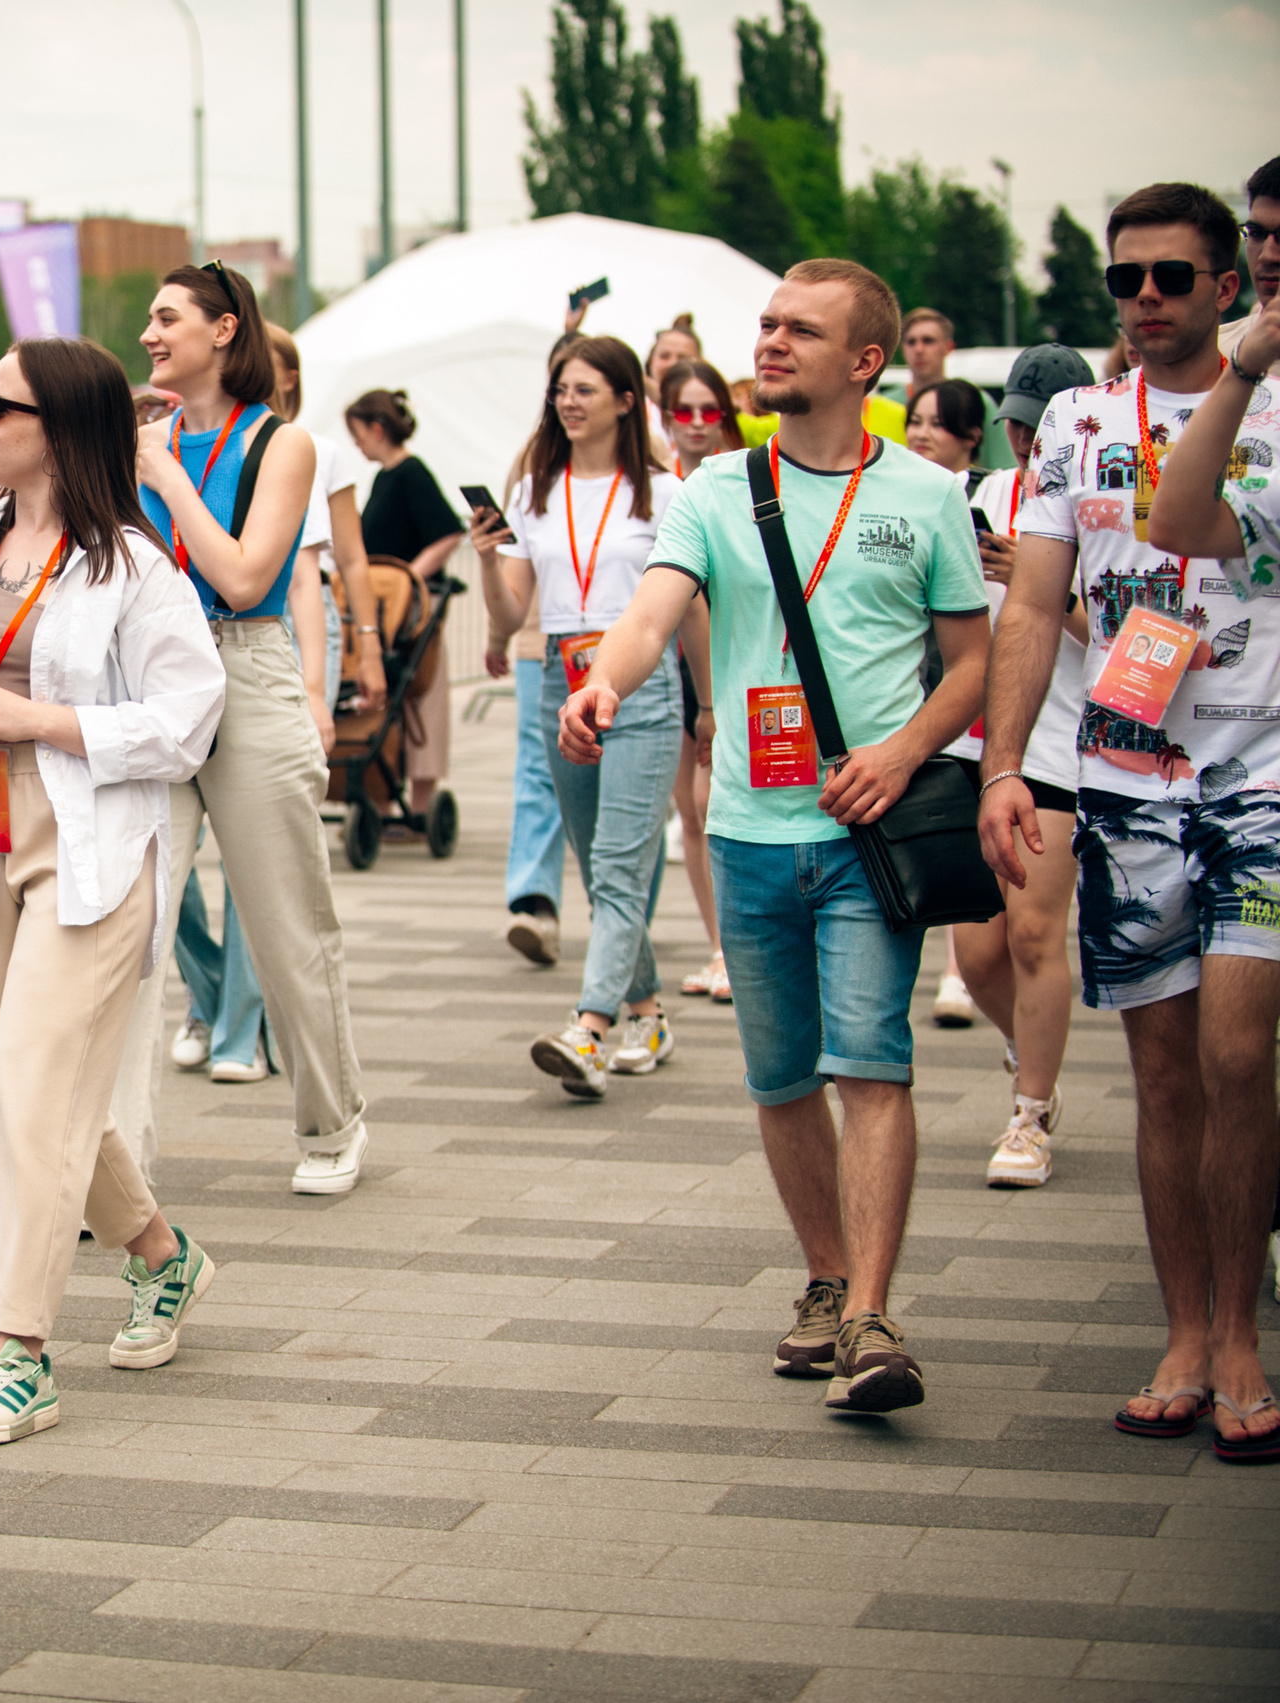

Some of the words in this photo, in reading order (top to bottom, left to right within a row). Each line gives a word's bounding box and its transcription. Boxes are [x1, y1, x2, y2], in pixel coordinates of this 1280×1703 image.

[857, 546, 914, 560] AMUSEMENT
[863, 556, 886, 564] URBAN
[888, 559, 907, 567] QUEST
[804, 561, 826, 600] ТУДВЕСНА
[1204, 581, 1230, 592] SUM
[1198, 708, 1248, 718] SUMMER
[1234, 880, 1268, 897] BEACH
